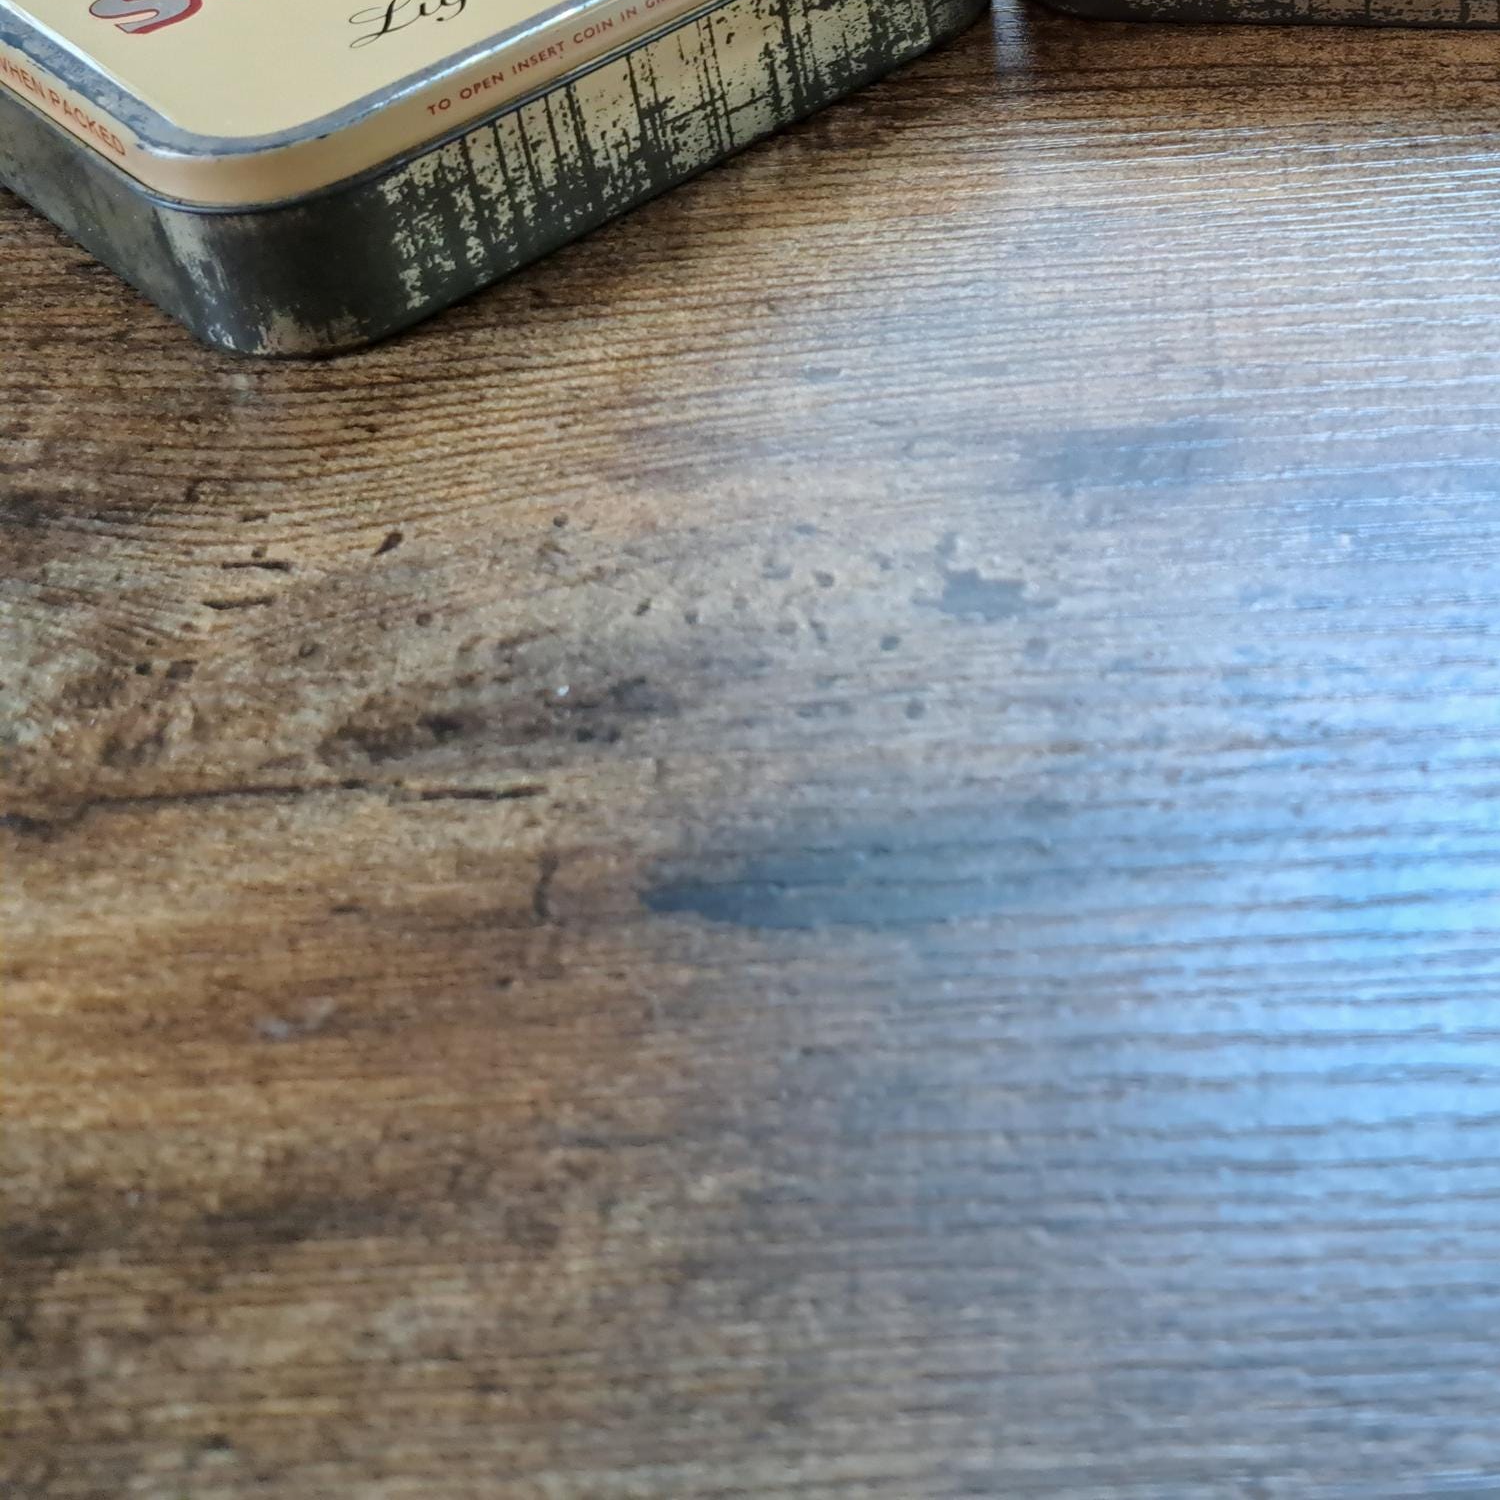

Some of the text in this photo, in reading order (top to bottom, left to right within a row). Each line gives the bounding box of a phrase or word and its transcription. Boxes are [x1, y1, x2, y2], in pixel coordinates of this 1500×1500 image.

[426, 98, 452, 116] TO
[459, 71, 505, 100] OPEN
[511, 40, 564, 73] INSERT
[573, 18, 614, 45] COIN
[620, 5, 637, 23] IN
